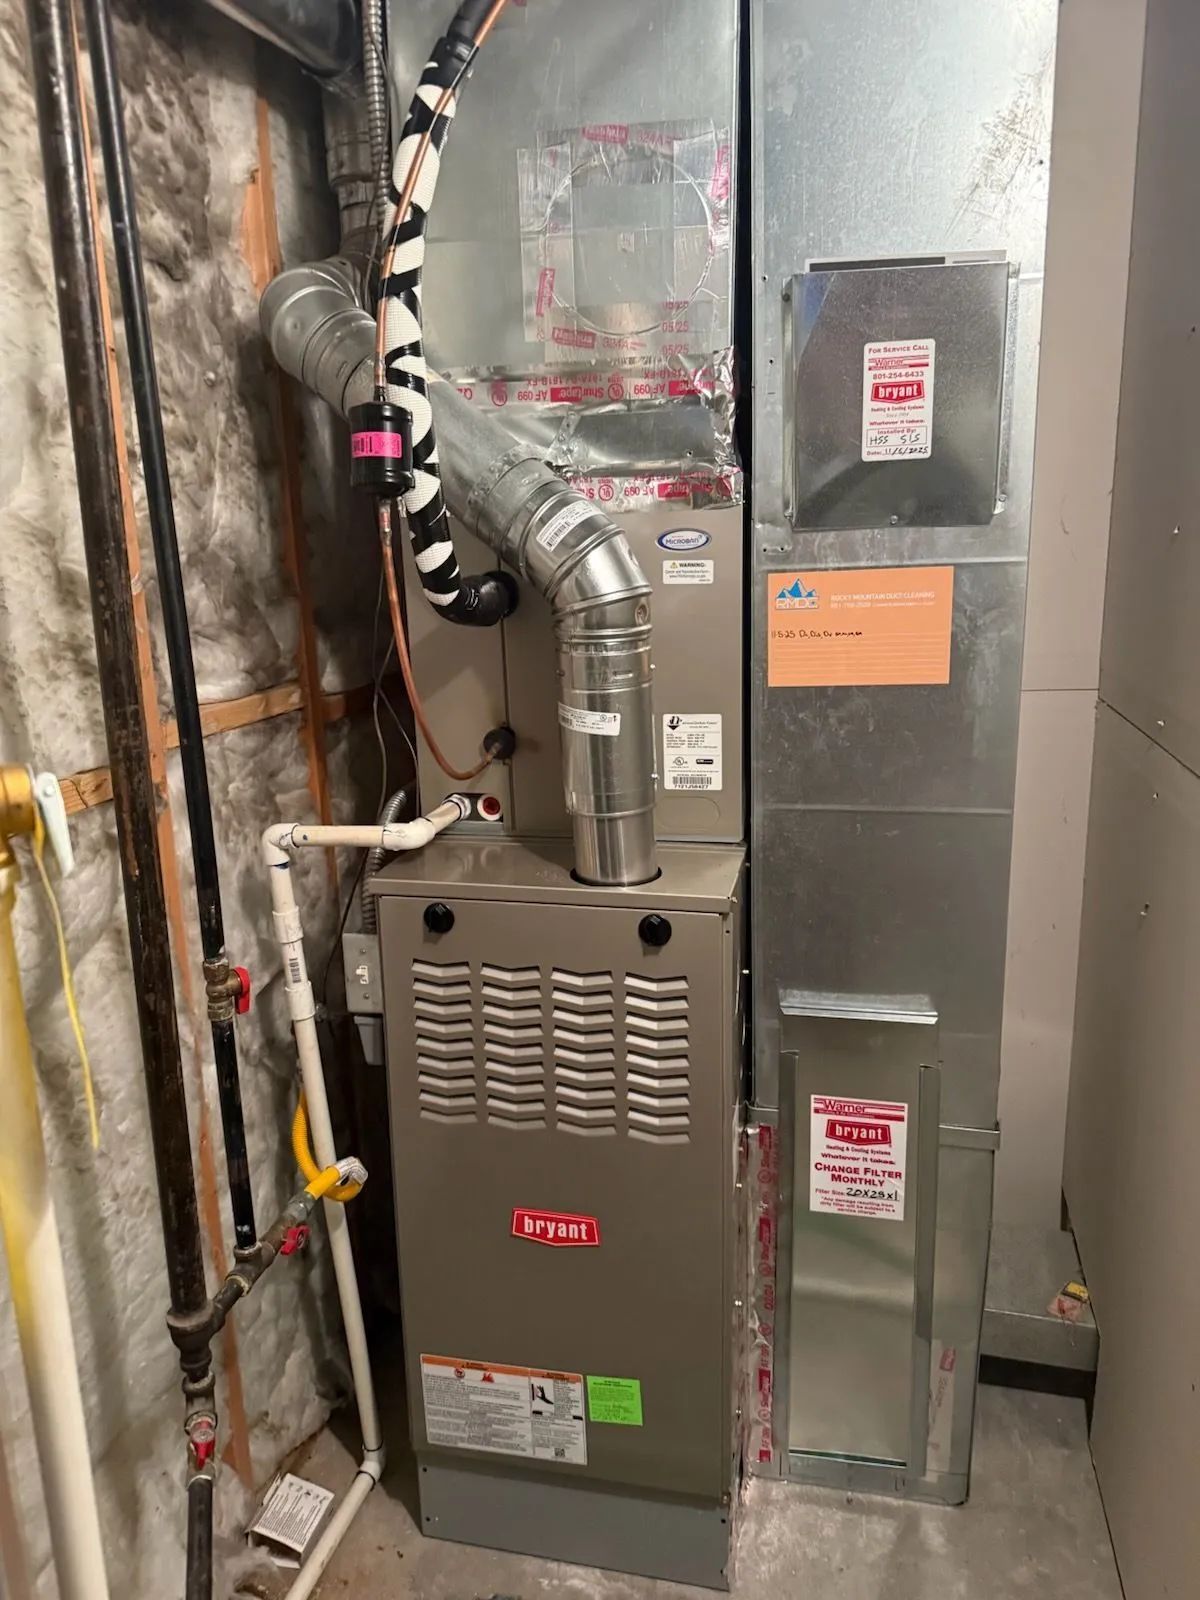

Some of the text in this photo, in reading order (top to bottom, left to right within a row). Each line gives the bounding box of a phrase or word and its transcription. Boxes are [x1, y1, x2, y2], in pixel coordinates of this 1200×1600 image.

[873, 371, 924, 380] 801-254-6433
[536, 389, 548, 400] AF
[634, 384, 651, 395] 099
[652, 384, 665, 395] AF
[879, 383, 918, 399] bryant
[518, 391, 534, 401] 099
[624, 486, 641, 497] 099
[903, 591, 935, 600] CLEANING
[835, 1123, 882, 1140] bryant
[821, 1152, 860, 1161] Whatever
[814, 1162, 903, 1180] CHANGE FILTER
[831, 1173, 885, 1187] MONTHLY
[523, 1215, 587, 1240] bryant
